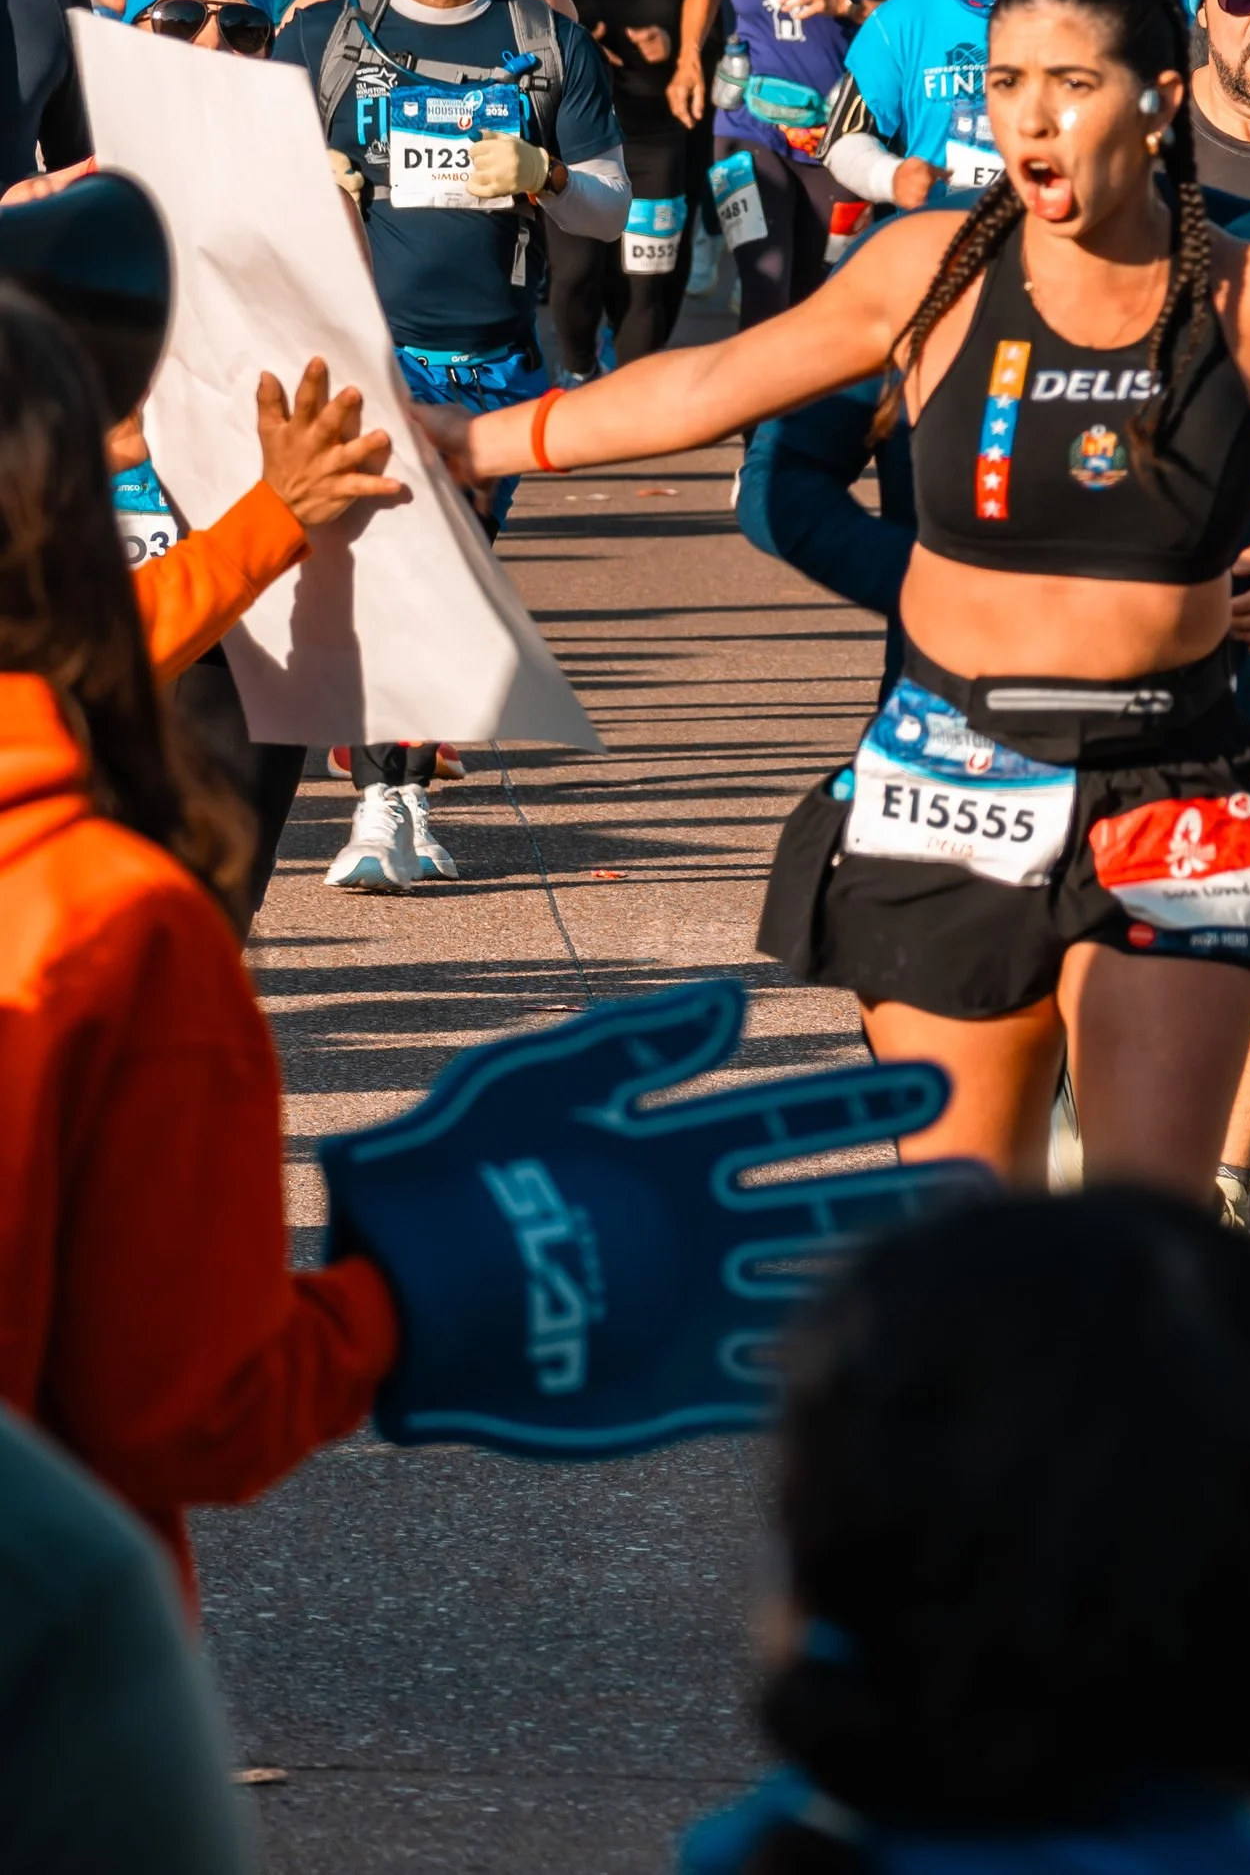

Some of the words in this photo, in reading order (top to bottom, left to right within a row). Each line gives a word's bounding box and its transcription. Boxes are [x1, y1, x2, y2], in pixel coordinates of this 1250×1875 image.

[428, 106, 472, 116] HOUSTON
[485, 107, 509, 116] 2026
[404, 148, 470, 170] D123
[431, 171, 469, 182] SIMBO
[973, 167, 1001, 186] E7
[123, 530, 179, 564] D3
[882, 783, 1036, 844] E15555
